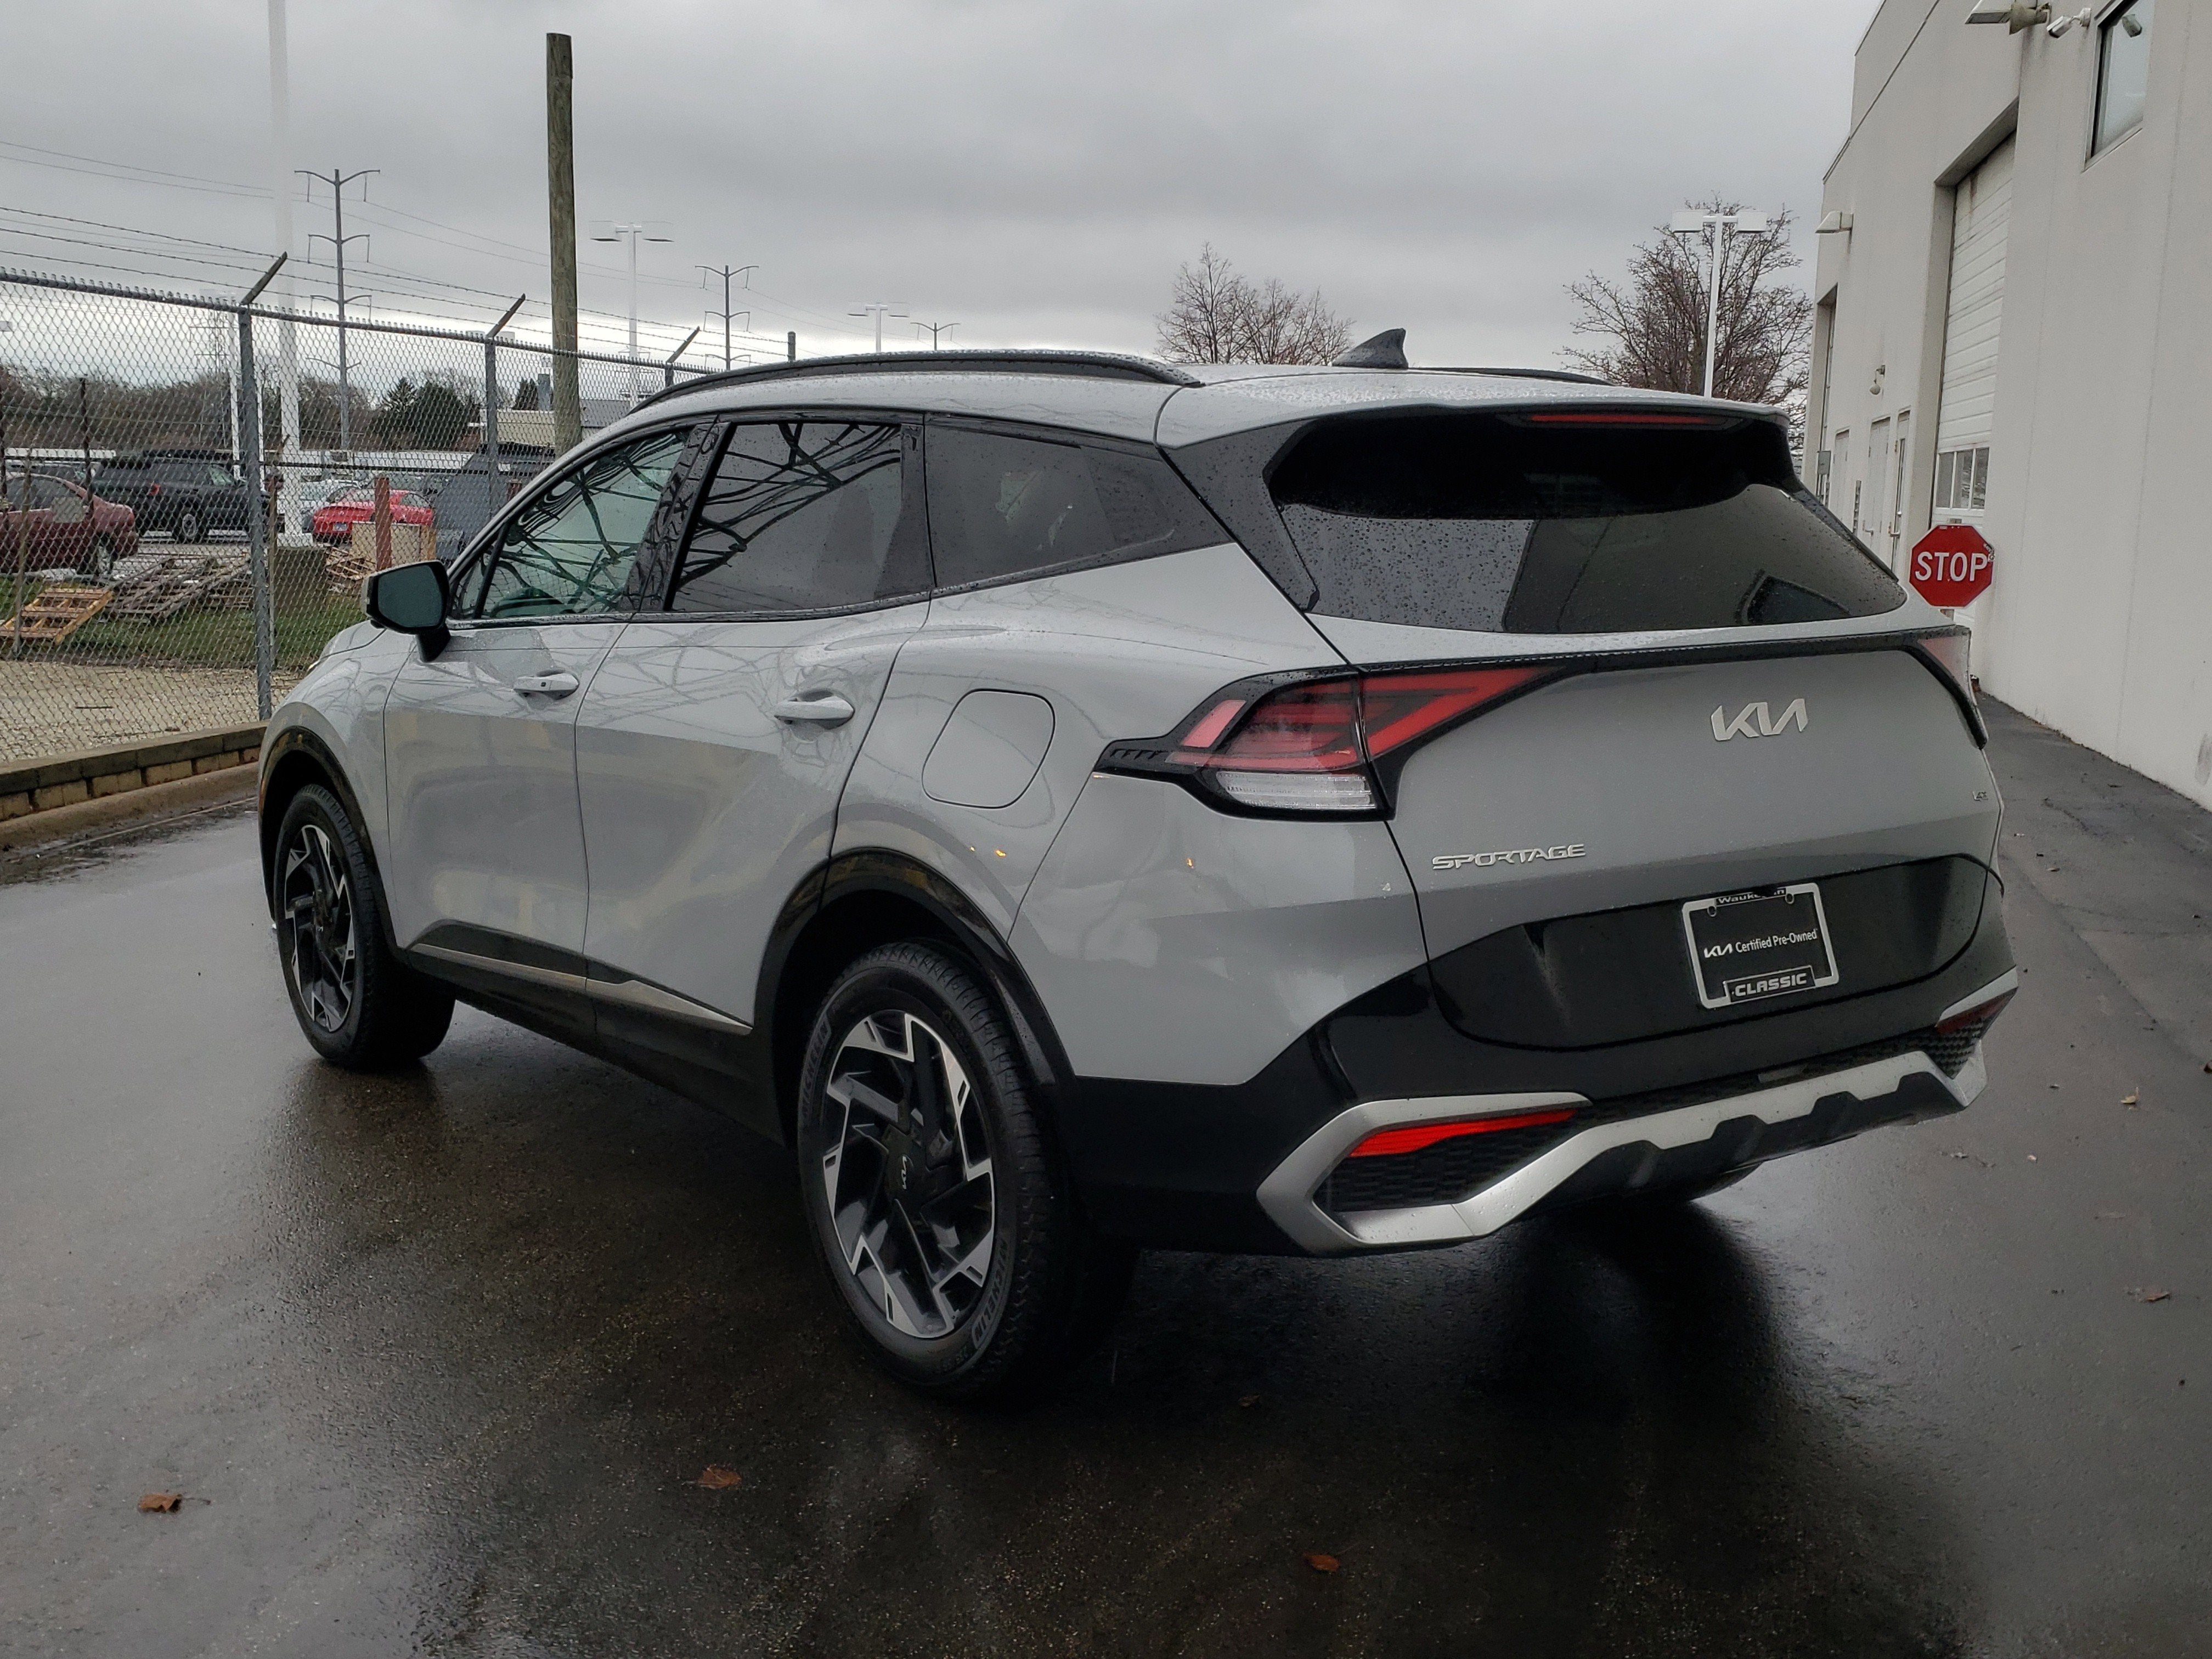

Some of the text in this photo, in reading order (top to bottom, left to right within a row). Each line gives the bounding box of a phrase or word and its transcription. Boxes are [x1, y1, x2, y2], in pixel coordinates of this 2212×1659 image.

[1915, 551, 1988, 582] STOP
[1431, 844, 1587, 870] SPORTAGE
[1735, 936, 1772, 953] Certified
[1773, 929, 1818, 946] Pre-Owned
[1734, 973, 1807, 997] CLASSIC
